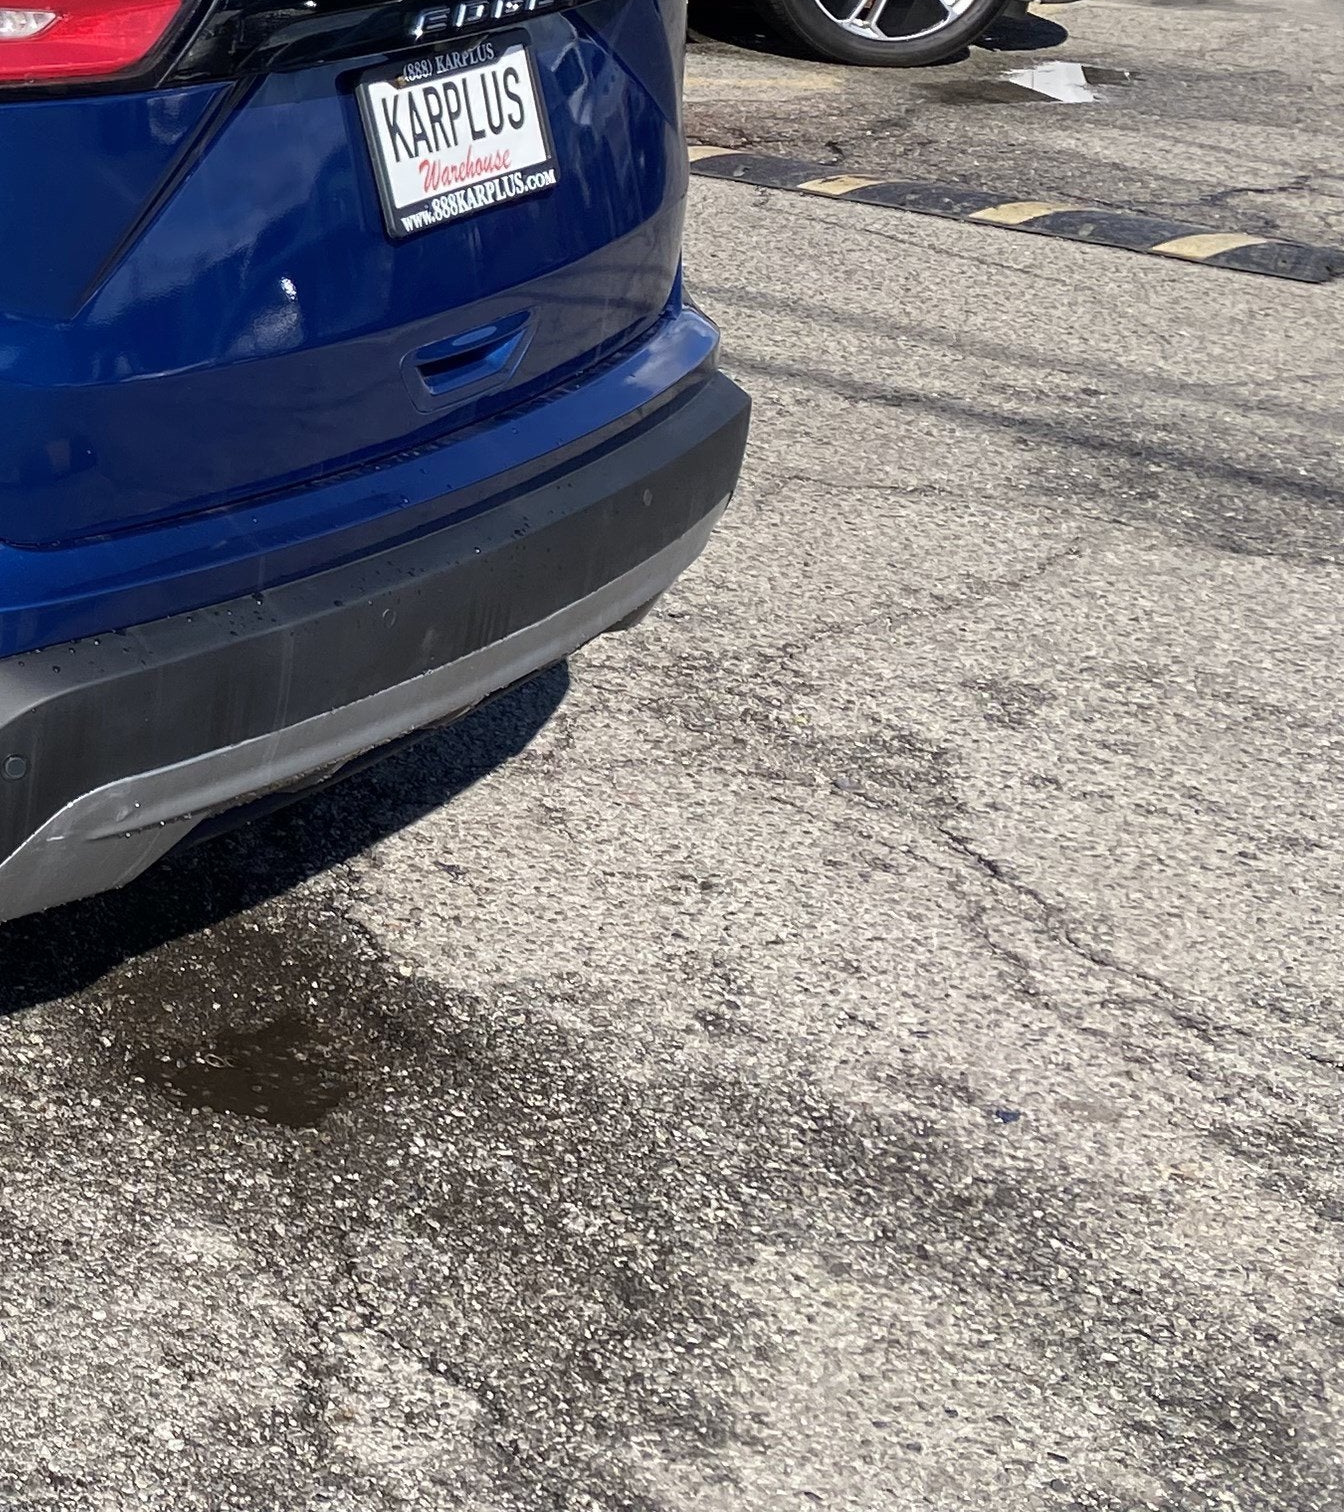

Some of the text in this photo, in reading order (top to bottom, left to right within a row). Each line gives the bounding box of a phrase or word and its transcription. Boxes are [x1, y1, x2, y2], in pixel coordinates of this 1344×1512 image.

[403, 42, 495, 82] (888) KARPLUS
[381, 66, 525, 163] KARPLUS
[419, 145, 512, 193] Warehouse
